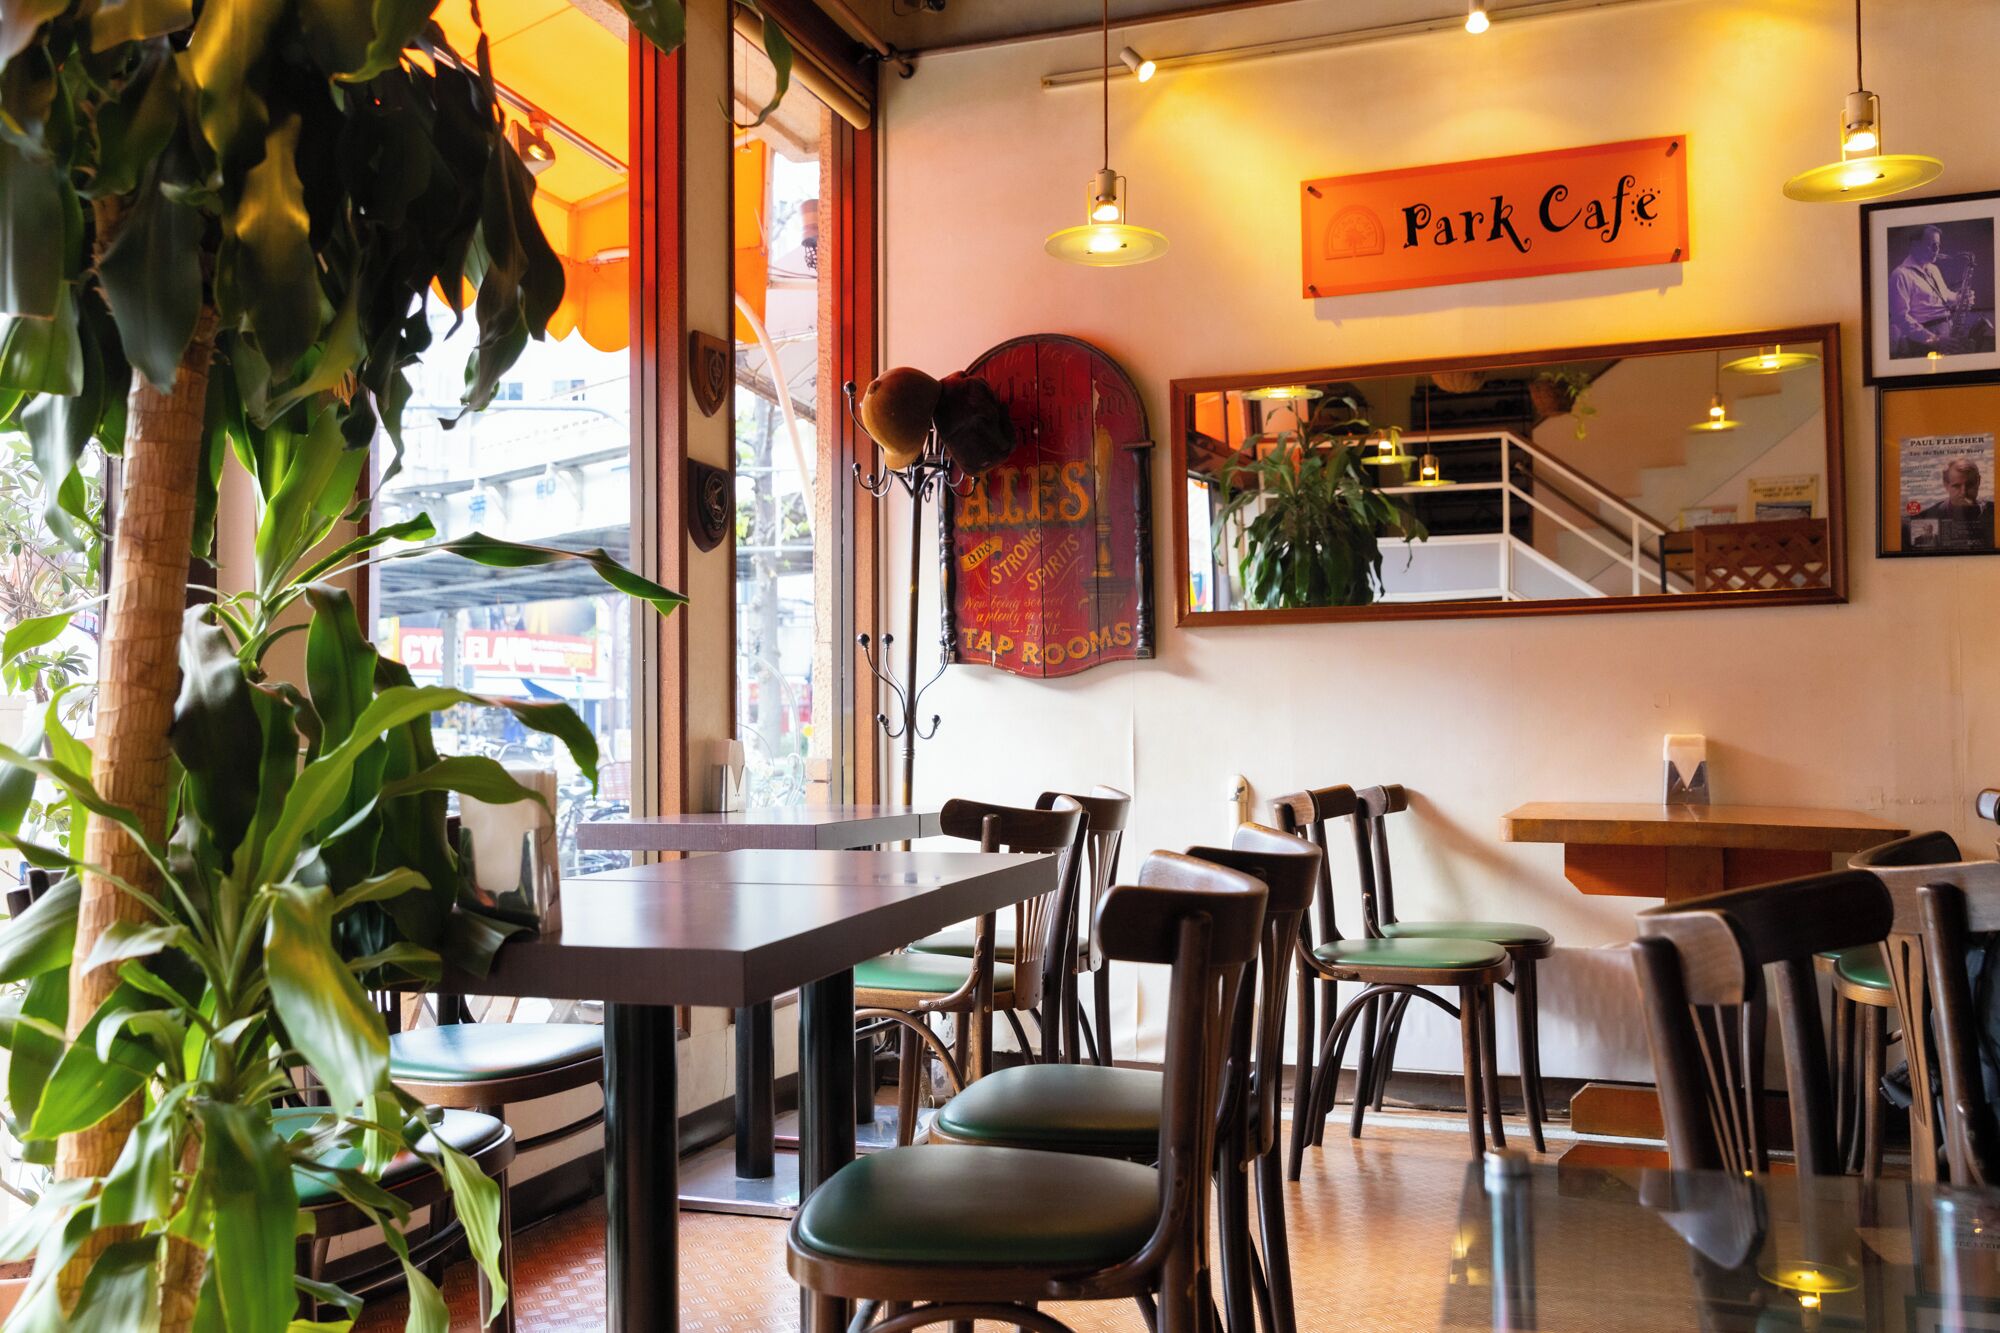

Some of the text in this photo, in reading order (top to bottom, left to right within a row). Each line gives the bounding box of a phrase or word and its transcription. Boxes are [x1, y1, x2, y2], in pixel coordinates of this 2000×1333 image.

[1402, 195, 1532, 253] Park
[1910, 437, 1985, 447] PAUL FLEISHER
[955, 461, 1089, 527] ALES
[990, 528, 1041, 585] STRONG
[1026, 533, 1080, 592] SPIRITS
[962, 622, 1134, 666] TAP ROOMS
